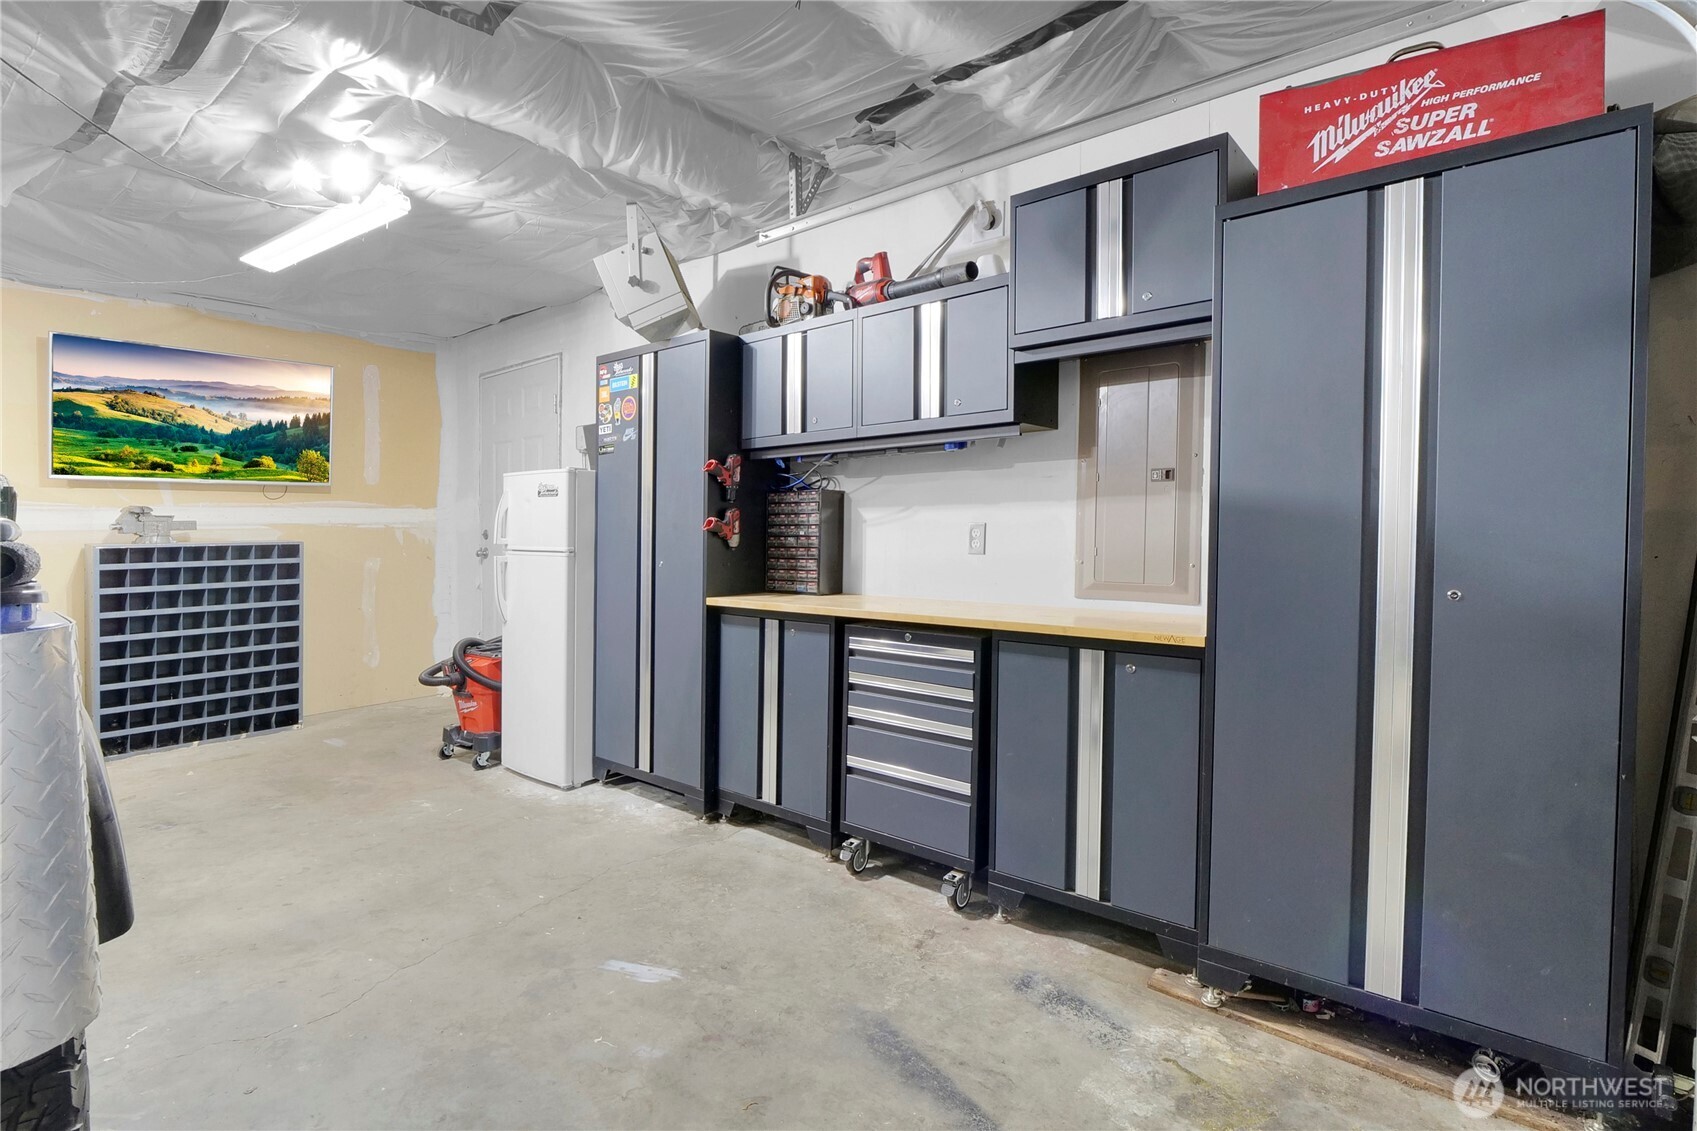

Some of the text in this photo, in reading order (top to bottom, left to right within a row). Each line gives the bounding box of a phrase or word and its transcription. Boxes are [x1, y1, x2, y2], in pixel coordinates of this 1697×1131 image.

[1304, 85, 1397, 113] HEAVY-DUTY
[1420, 72, 1542, 107] HIGH PERFORMANCE
[1307, 68, 1441, 166] Milwaukee
[1393, 102, 1478, 135] SUPER
[1374, 119, 1492, 157] SAWZALL
[600, 425, 612, 433] YETI
[1154, 635, 1185, 643] NEWAGE
